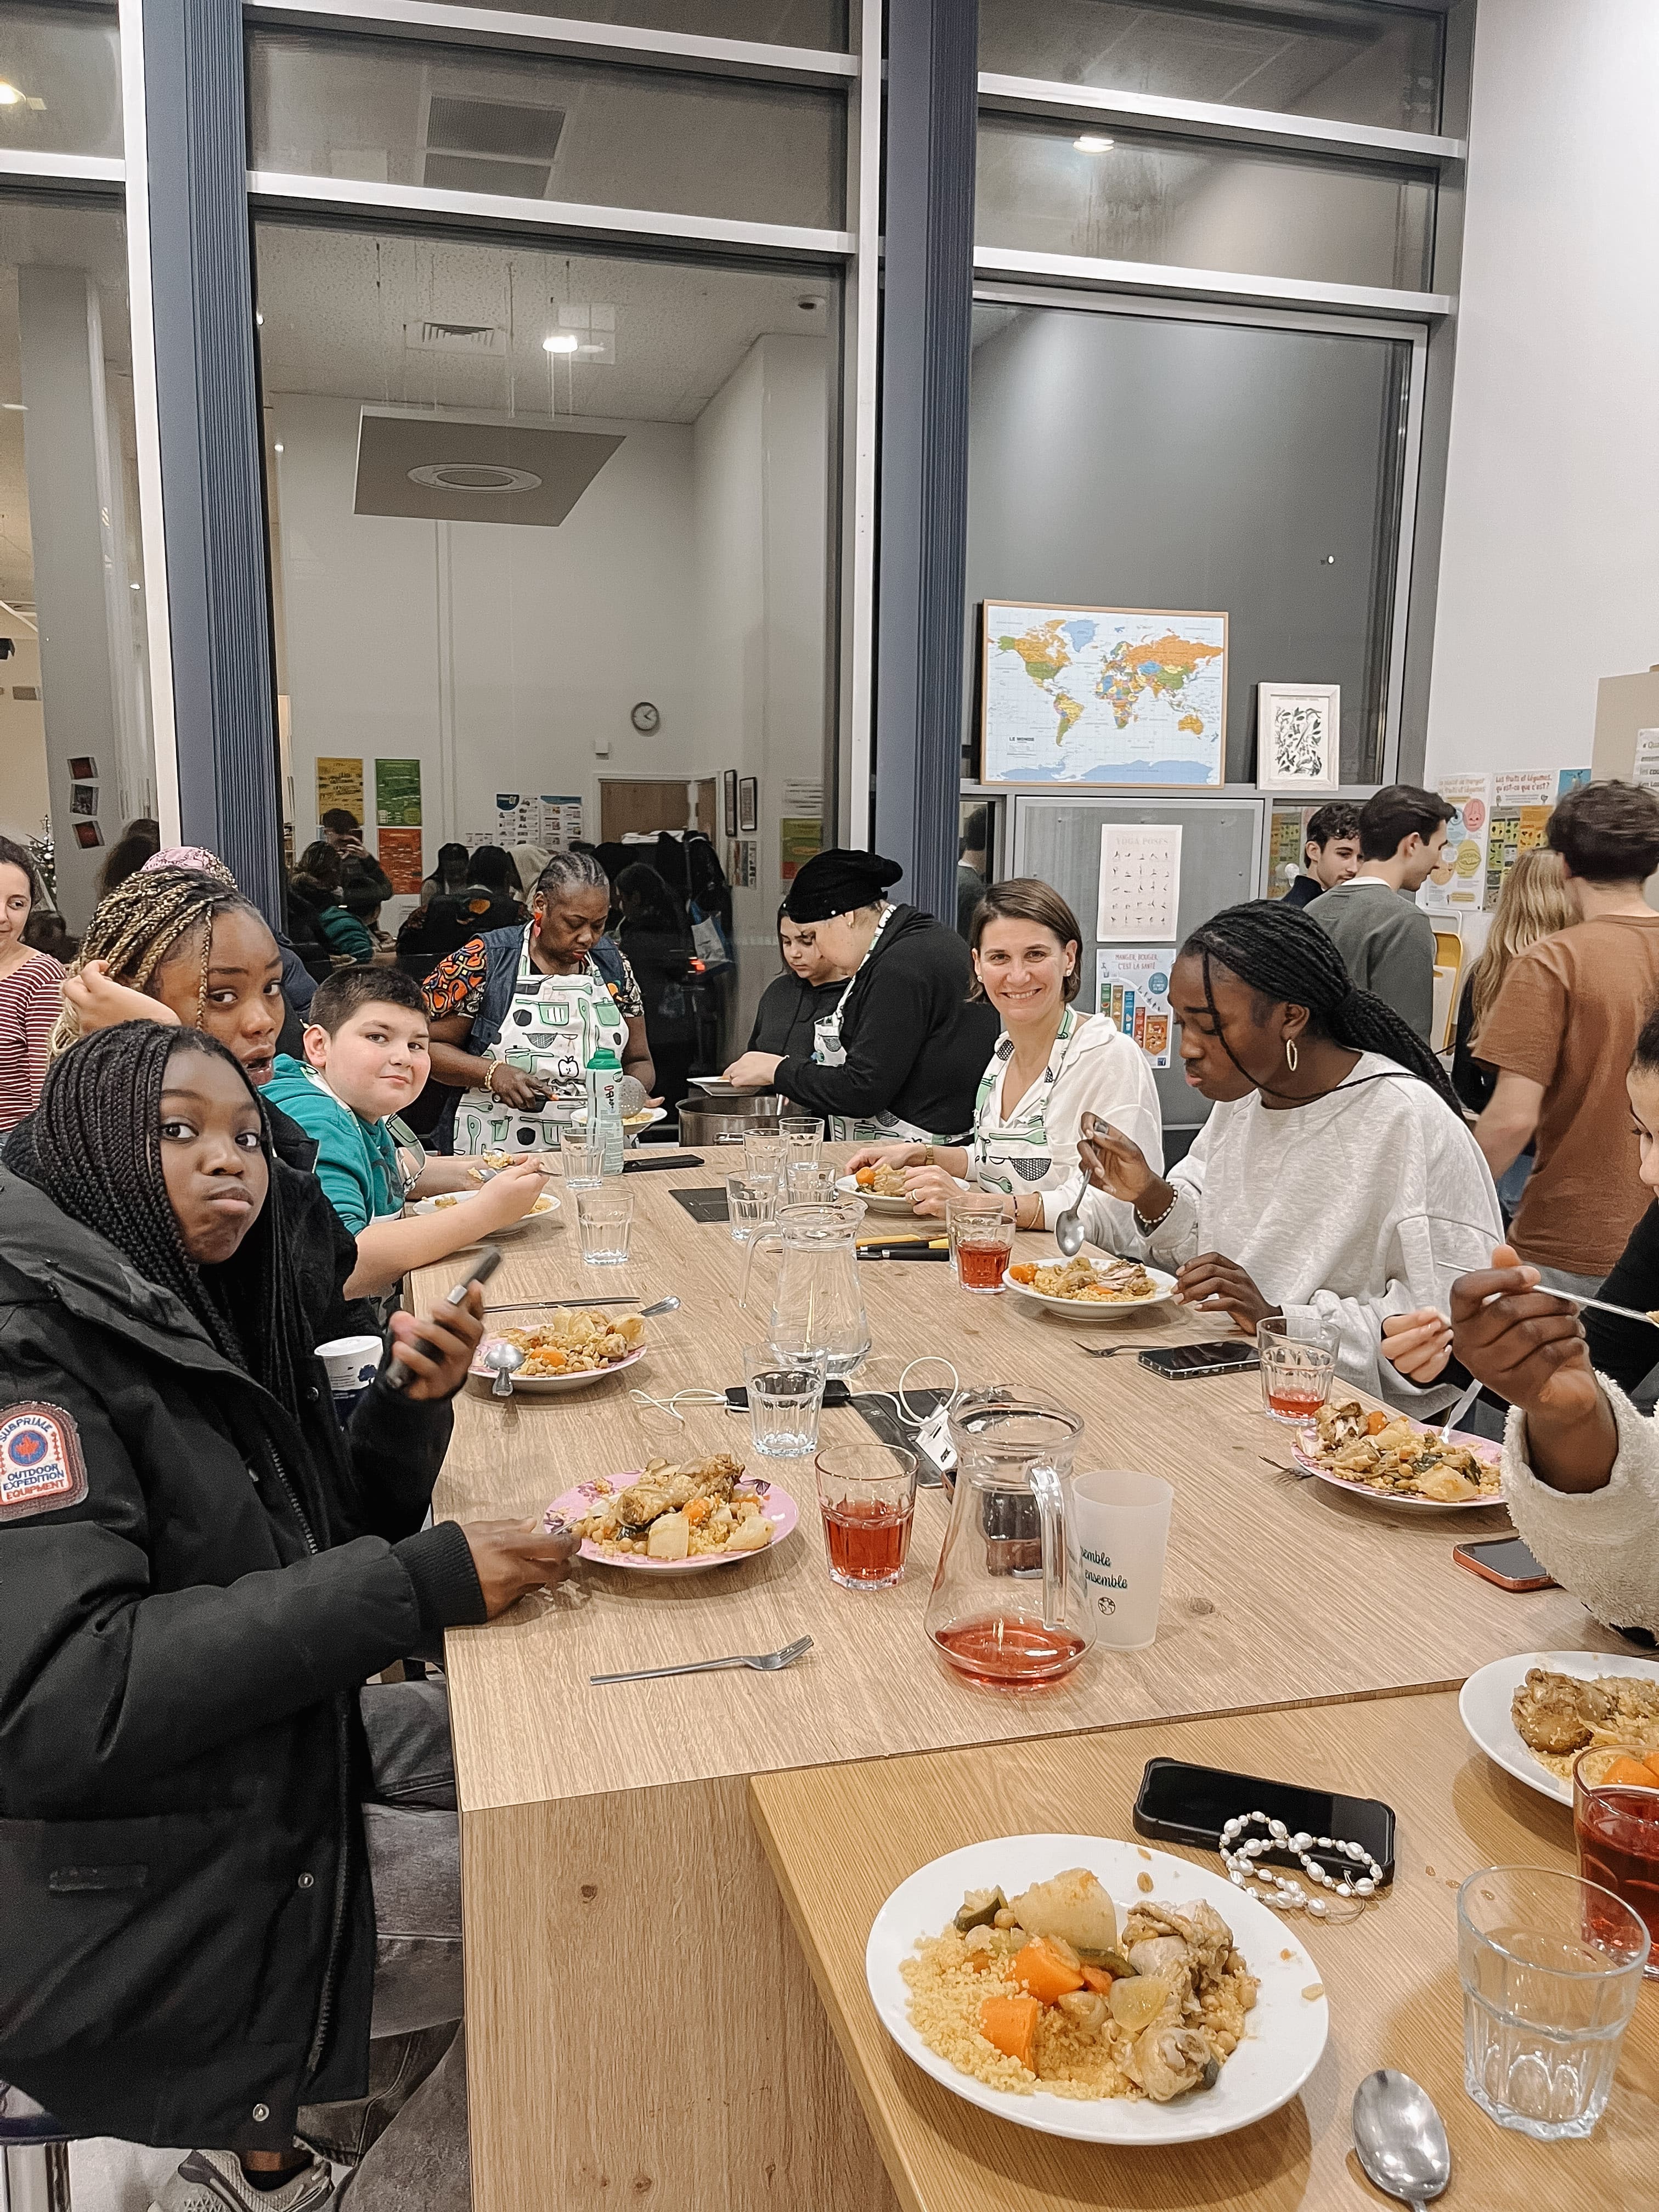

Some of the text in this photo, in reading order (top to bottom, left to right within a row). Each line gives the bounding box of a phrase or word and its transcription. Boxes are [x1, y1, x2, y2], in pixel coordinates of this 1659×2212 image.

[0, 1417, 53, 1442] SUBPRIME
[3, 1470, 65, 1491] EXPEDITION
[8, 1463, 59, 1481] OUTDOOR
[6, 1479, 65, 1500] EQUIPMENT
